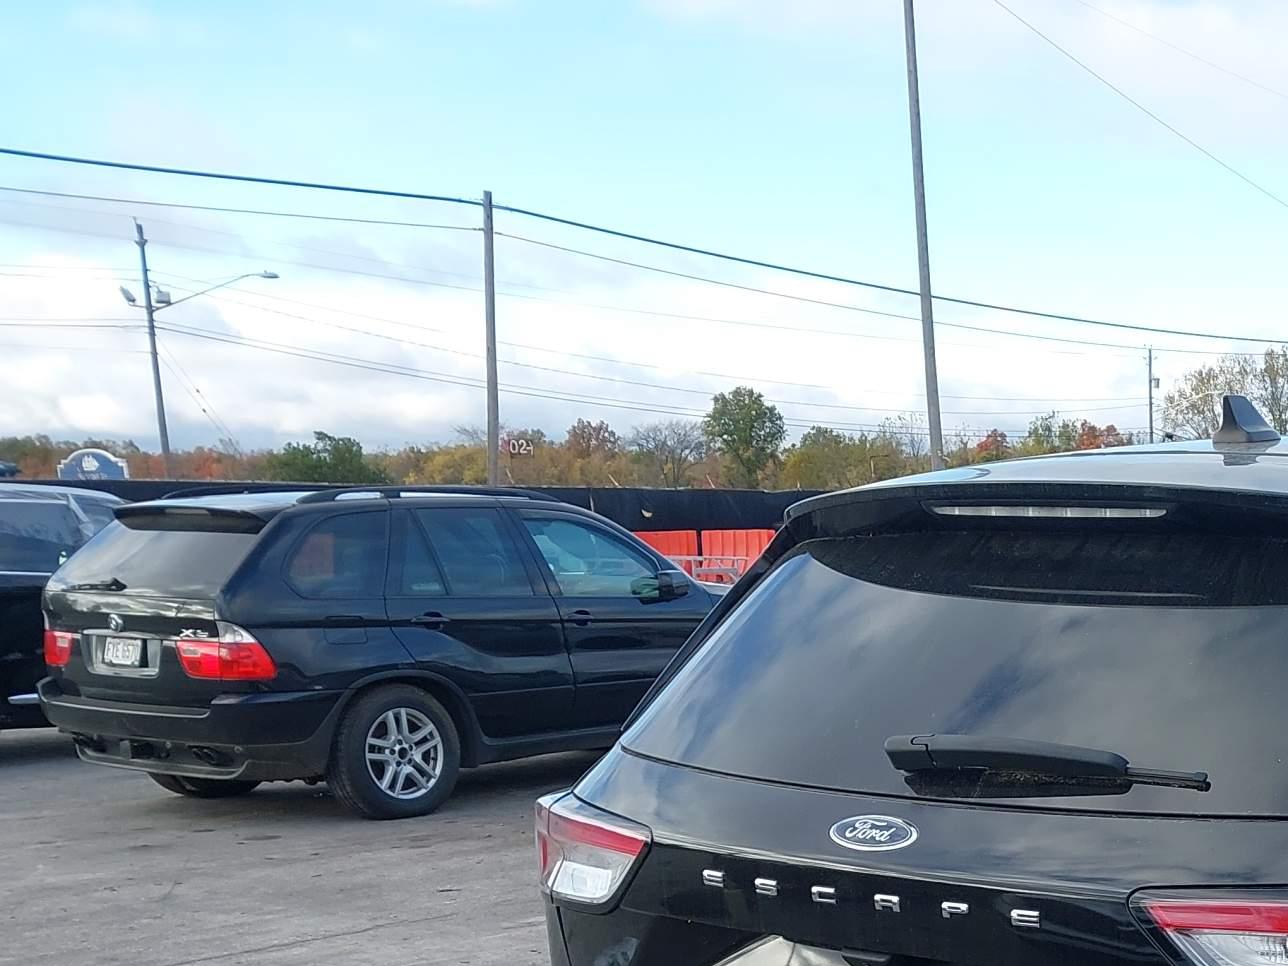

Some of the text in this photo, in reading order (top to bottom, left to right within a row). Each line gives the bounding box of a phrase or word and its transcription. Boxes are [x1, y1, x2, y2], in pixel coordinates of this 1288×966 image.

[180, 628, 209, 638] X5
[846, 819, 896, 843] Ford
[702, 869, 1041, 928] ESCAPE
